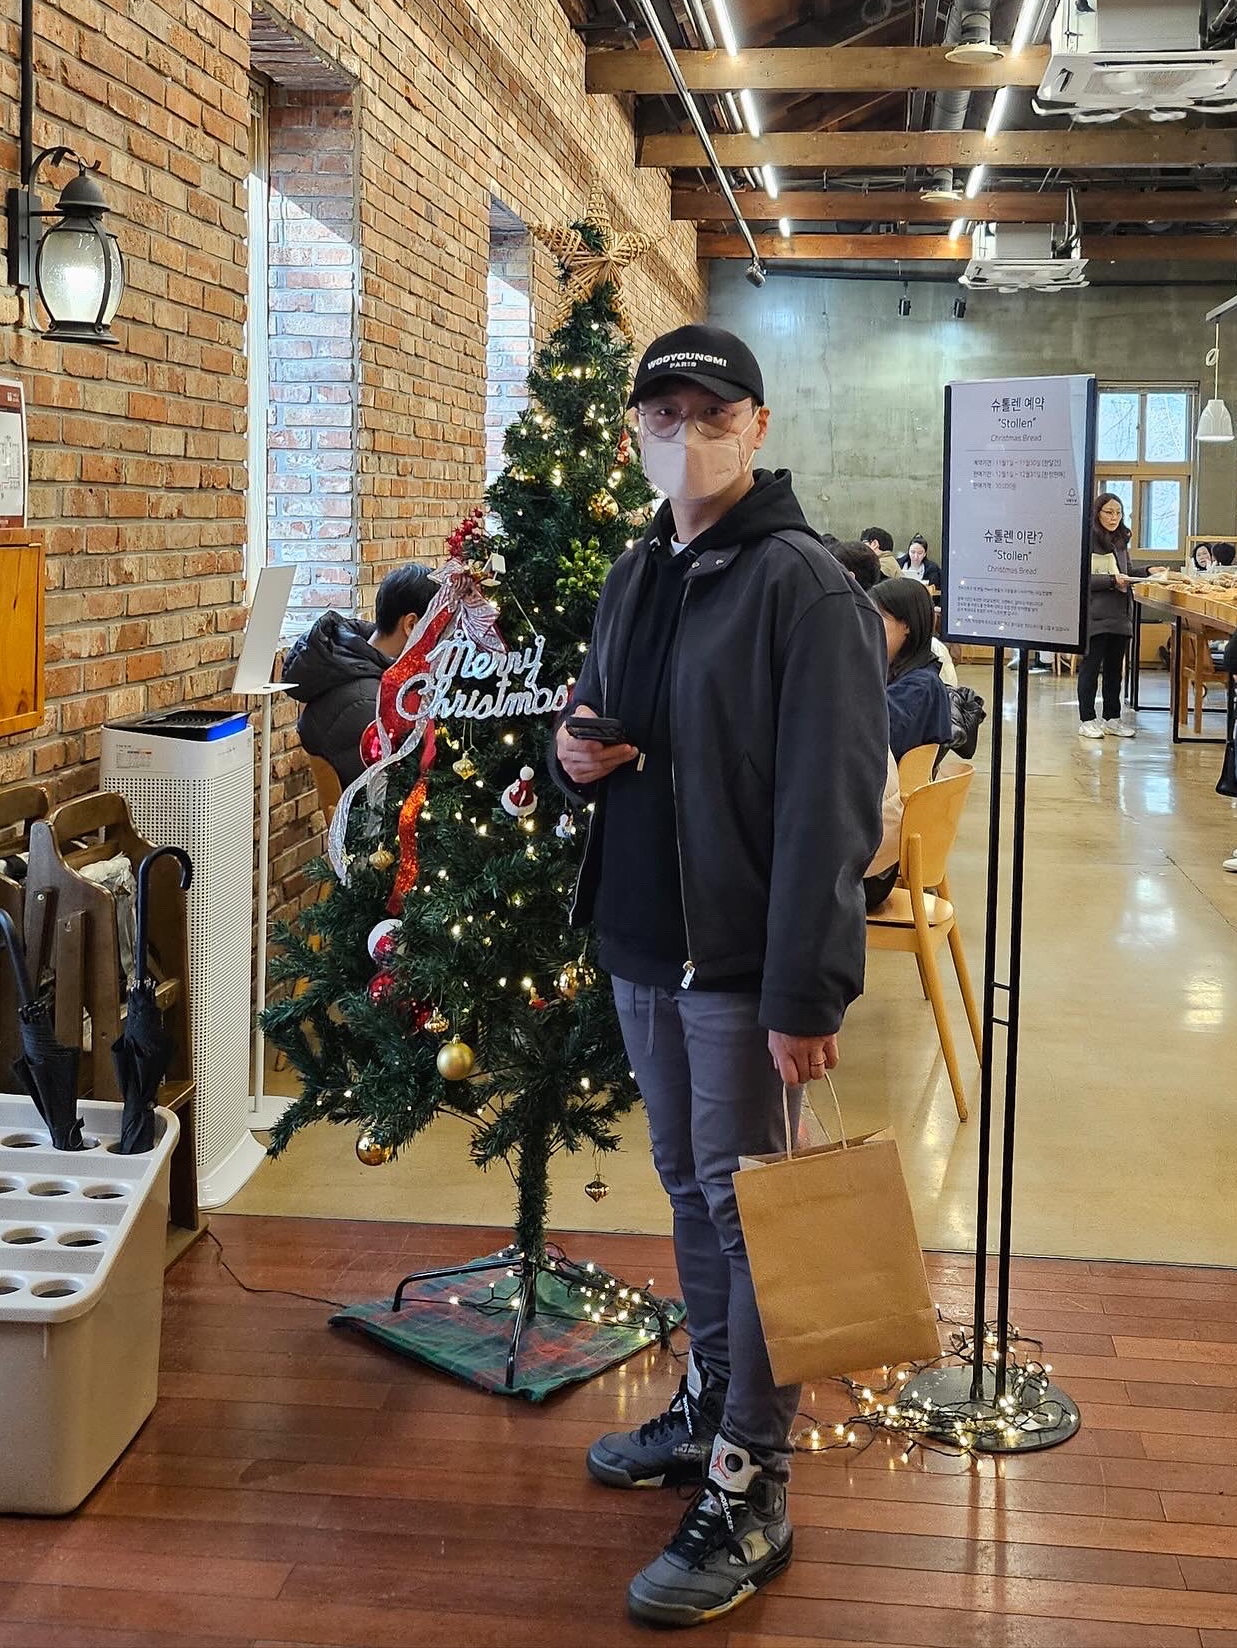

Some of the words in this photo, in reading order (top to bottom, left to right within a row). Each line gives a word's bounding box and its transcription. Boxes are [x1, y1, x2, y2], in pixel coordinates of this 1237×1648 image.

[647, 352, 728, 370] WOOYOUNGMI
[669, 361, 697, 369] PARIS
[991, 397, 1021, 412] 슈톨렌
[1024, 396, 1045, 411] 예약
[990, 434, 1022, 443] Christmas
[1022, 434, 1042, 442] Bread
[983, 528, 1014, 544] 슈톨렌
[1016, 529, 1044, 545] 이란?
[987, 564, 1018, 574] Christmas
[1018, 566, 1037, 575] Bread
[425, 634, 547, 687] Merry
[395, 673, 569, 721] Christmas
